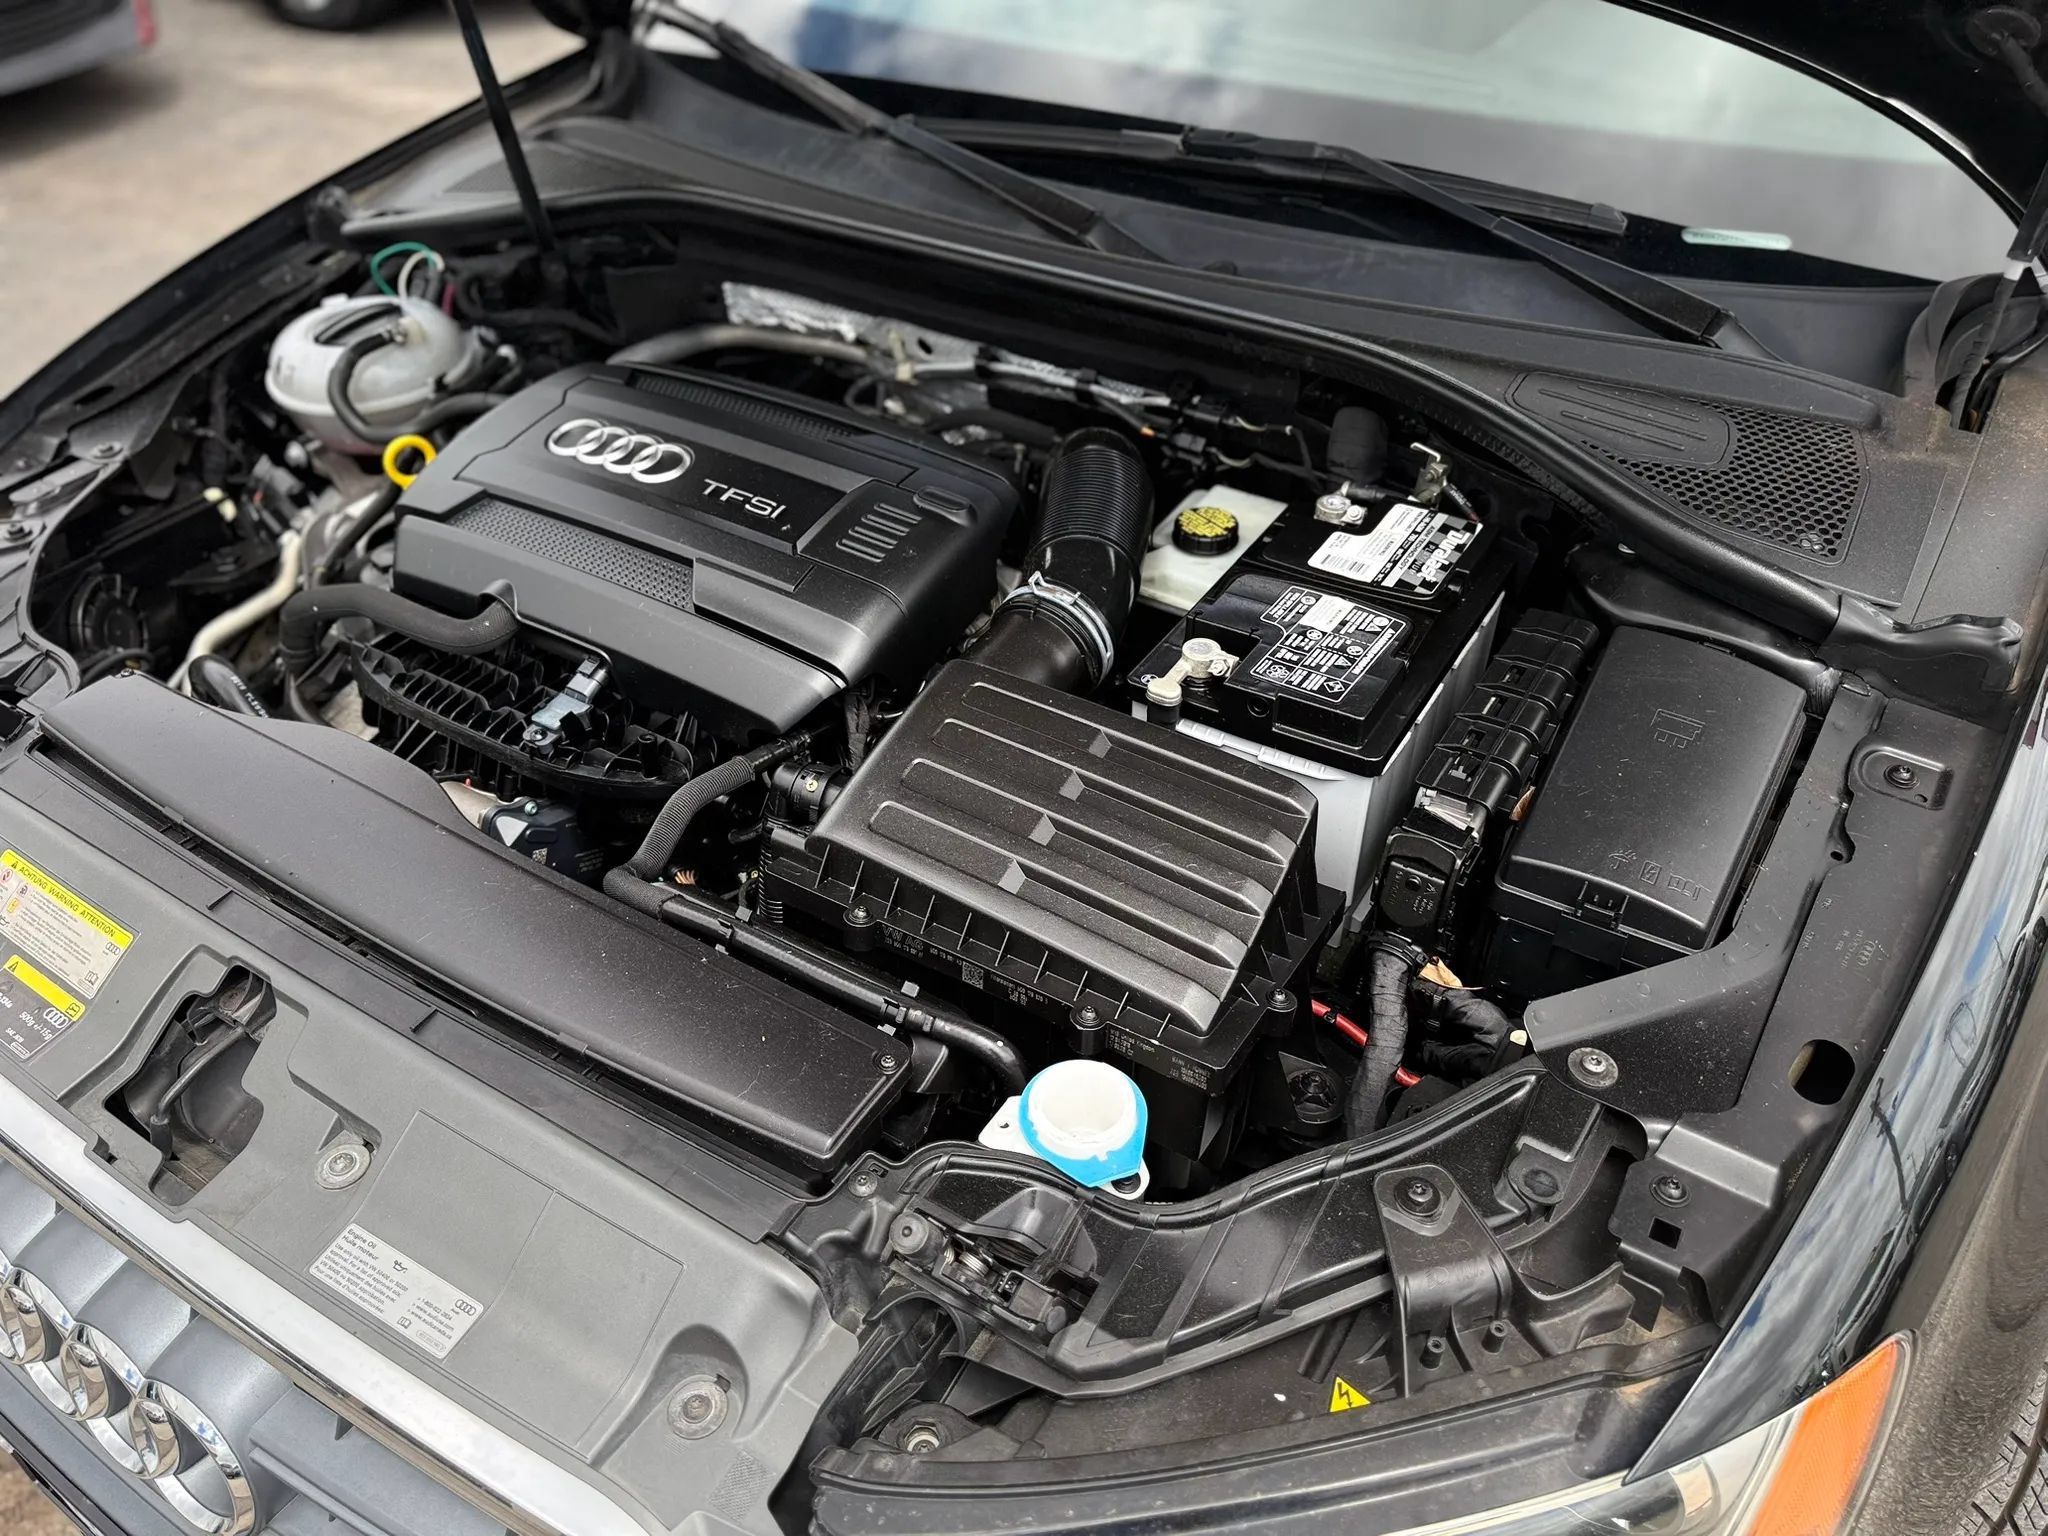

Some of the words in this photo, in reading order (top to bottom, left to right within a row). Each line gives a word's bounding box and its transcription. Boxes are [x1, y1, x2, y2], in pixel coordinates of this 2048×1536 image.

[702, 478, 787, 520] TFSI
[1416, 529, 1471, 583] Duralast
[19, 866, 48, 890] ACHTUNG
[49, 887, 79, 912] WARNING
[80, 909, 116, 937] ATTENTION
[19, 1011, 36, 1027] 500g
[341, 1235, 357, 1246] Huile
[356, 1245, 378, 1260] moteur
[347, 1228, 367, 1243] Engine
[366, 1241, 376, 1249] Oil
